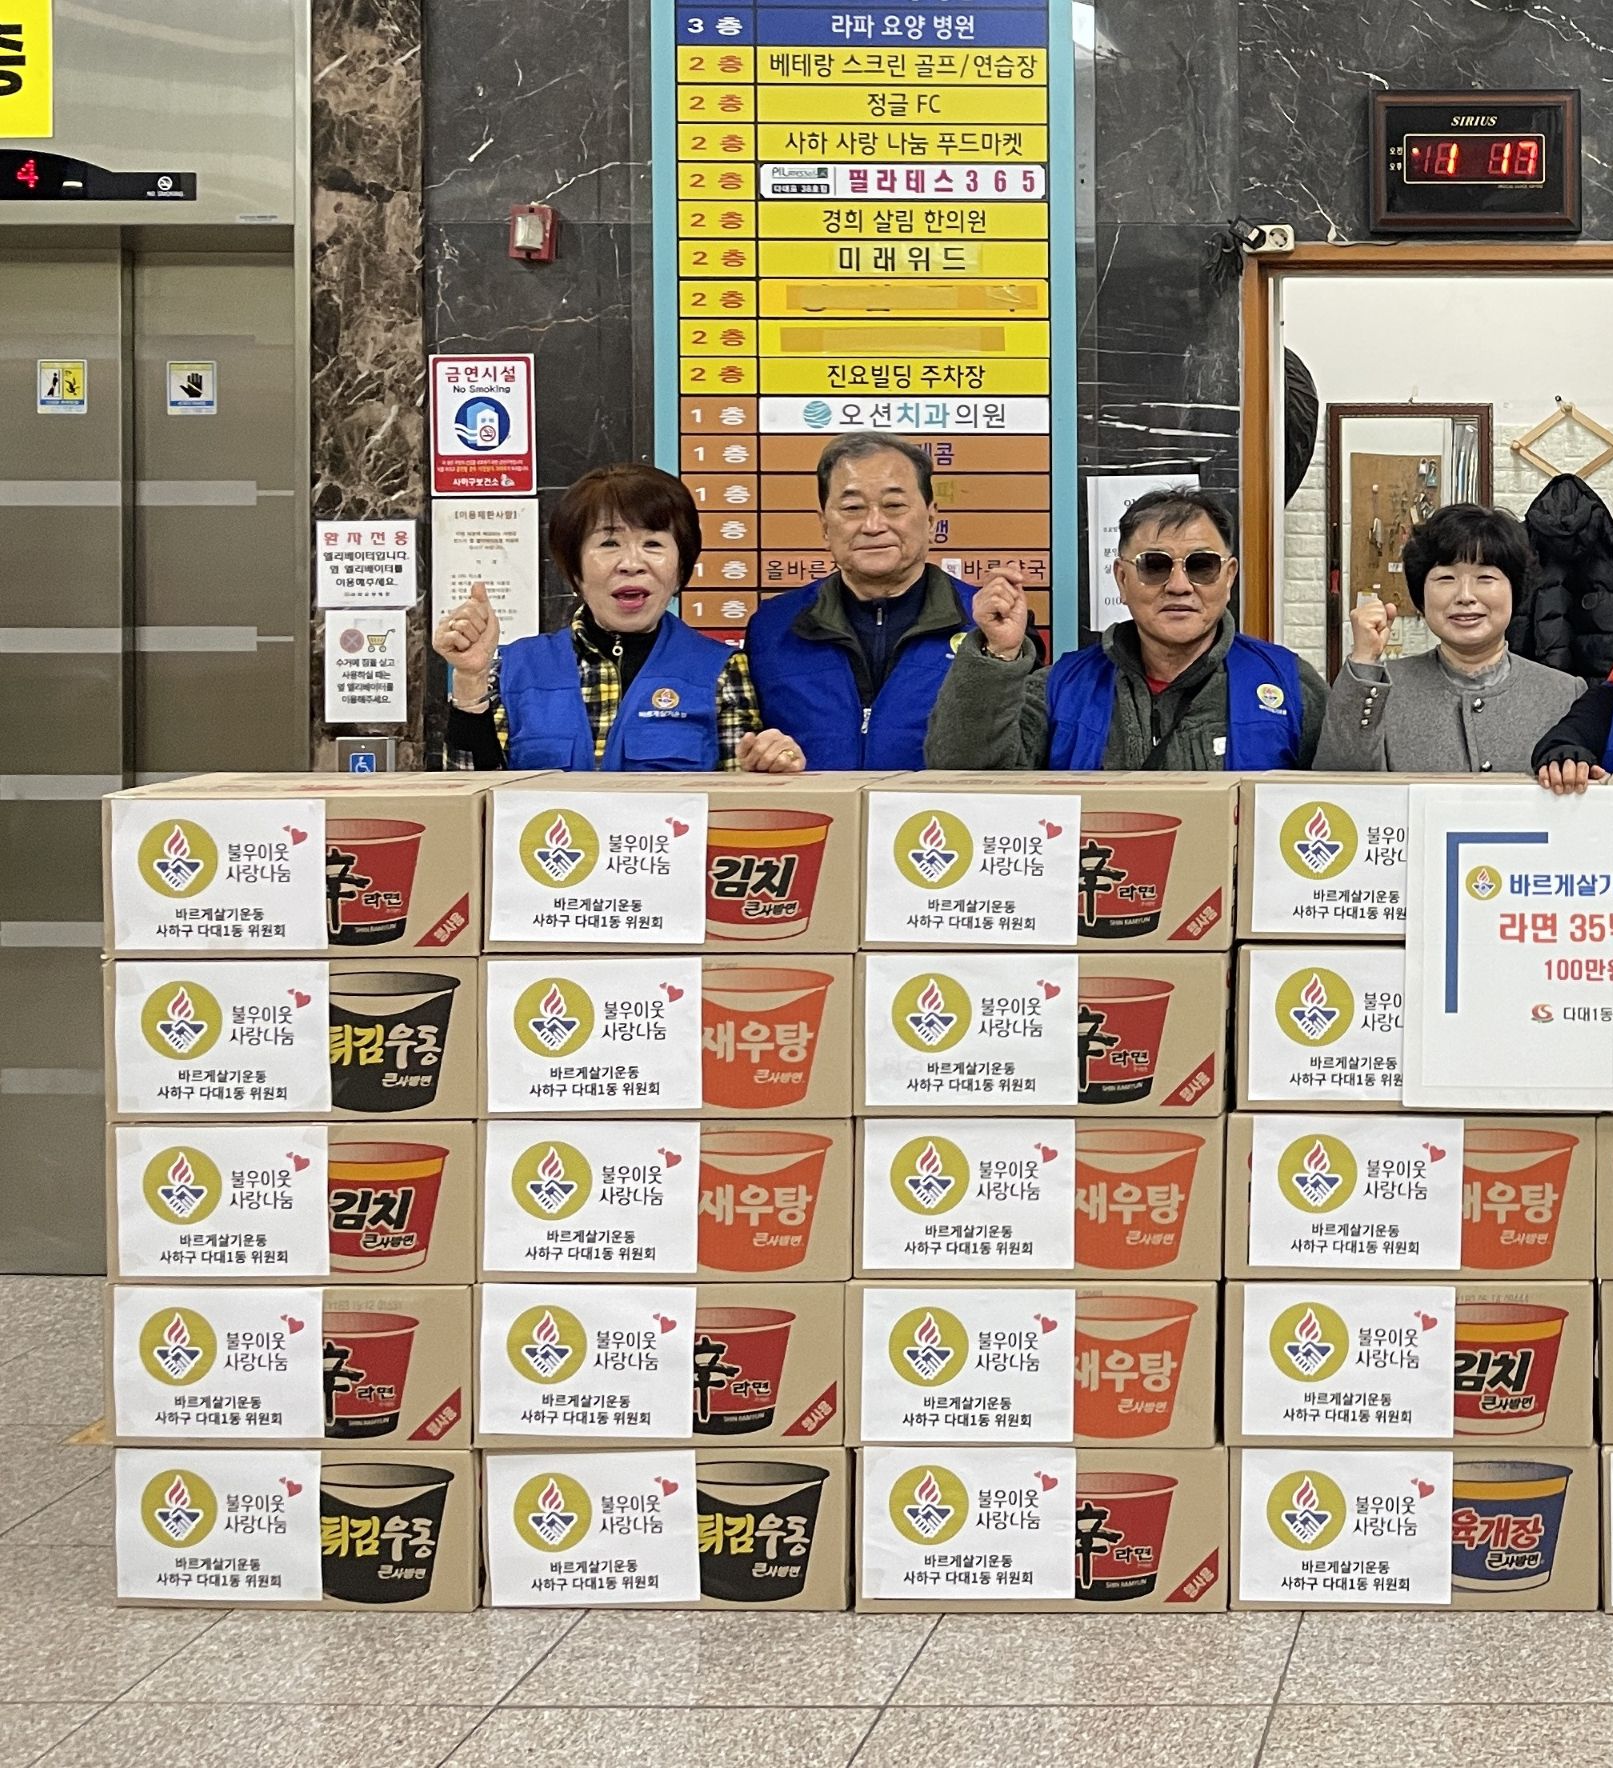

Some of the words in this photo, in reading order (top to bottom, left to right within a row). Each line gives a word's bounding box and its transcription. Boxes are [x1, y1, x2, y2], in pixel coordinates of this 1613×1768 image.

[832, 15, 875, 39] 라파
[881, 15, 925, 40] 요양
[934, 15, 974, 40] 병원
[770, 54, 834, 77] 베테랑
[842, 54, 905, 77] 스크린
[868, 93, 908, 116] 정글
[918, 94, 940, 113] FC
[1451, 116, 1497, 126] SIRIUS
[786, 132, 828, 154] 사하
[836, 132, 878, 155] 사랑
[888, 132, 928, 155] 나눔
[937, 133, 1022, 156] 푸드마켓
[16, 160, 39, 188] 4
[823, 209, 862, 233] 경희
[873, 210, 913, 233] 살림
[925, 210, 986, 233] 한의원
[445, 366, 515, 383] 금연시설
[828, 365, 910, 388] 진요빌딩
[921, 365, 985, 389] 주차장
[453, 385, 466, 393] No
[470, 385, 510, 393] Smoking
[453, 478, 500, 486] 사하구보건소
[323, 551, 409, 561] 엘리베이터입니다.
[344, 565, 402, 574] 엘리베이터를
[336, 577, 398, 587] 이용해주세요.
[983, 836, 1042, 855] 불우이웃
[979, 857, 1044, 876] 사랑나눔
[712, 855, 796, 899] 김치
[361, 891, 402, 908] 라면
[928, 899, 1016, 913] 바르게살기운동
[907, 915, 944, 928] 사하구
[949, 916, 994, 930] 다대1동
[999, 917, 1035, 930] 위원회
[1500, 913, 1557, 943] 라면
[1564, 1007, 1612, 1022] 다대1동
[702, 1020, 814, 1065] 새우탕
[232, 1170, 291, 1188] 불우이웃
[230, 1187, 293, 1209] 사랑나눔
[330, 1189, 414, 1231] 김치
[180, 1234, 267, 1247] 바르게살기운동
[160, 1250, 196, 1264] 사하구
[201, 1250, 246, 1264] 다대1동
[252, 1250, 288, 1263] 위원회
[1356, 1496, 1415, 1515] 불우이웃
[1353, 1517, 1417, 1536] 사랑나눔
[1302, 1560, 1389, 1574] 바르게살기운동
[1281, 1577, 1318, 1590] 사하구
[1323, 1577, 1368, 1591] 다대1동
[1373, 1578, 1409, 1591] 위원회
